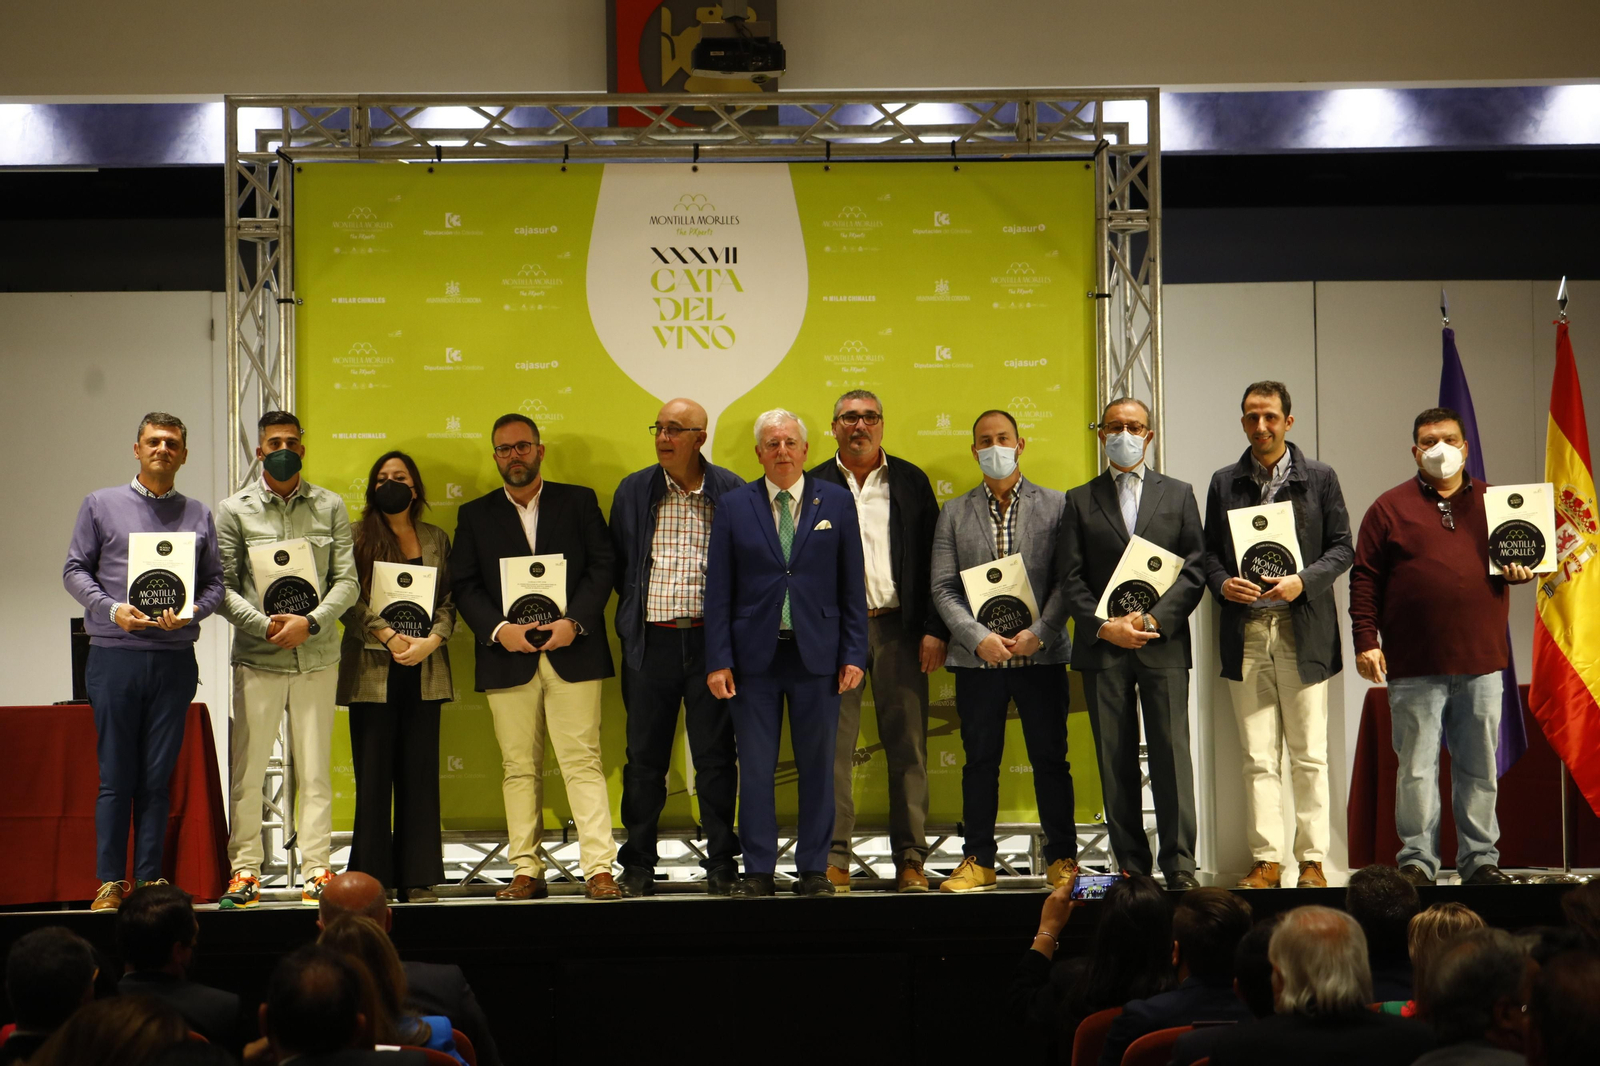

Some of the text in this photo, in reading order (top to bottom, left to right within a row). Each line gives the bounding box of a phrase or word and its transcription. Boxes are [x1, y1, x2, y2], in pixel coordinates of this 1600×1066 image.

[649, 215, 695, 225] MONTILLA
[514, 225, 550, 236] cajasur
[676, 228, 687, 236] the
[1002, 224, 1038, 235] cajasur
[650, 246, 737, 264] XXXVII
[650, 268, 744, 293] CATA
[652, 297, 726, 321] DEL
[652, 325, 736, 349] VINO
[515, 360, 550, 371] cajasur
[1004, 358, 1039, 369] cajasur
[1498, 540, 1536, 549] MONTILLA
[1252, 556, 1287, 576] MONTILLA
[139, 589, 177, 598] MONTILLA
[273, 592, 309, 610] MONTILLA
[517, 612, 552, 625] MONTILLA
[987, 610, 1022, 629] MONTILLA
[395, 629, 421, 637] ORILES
[1009, 763, 1033, 775] cajas
